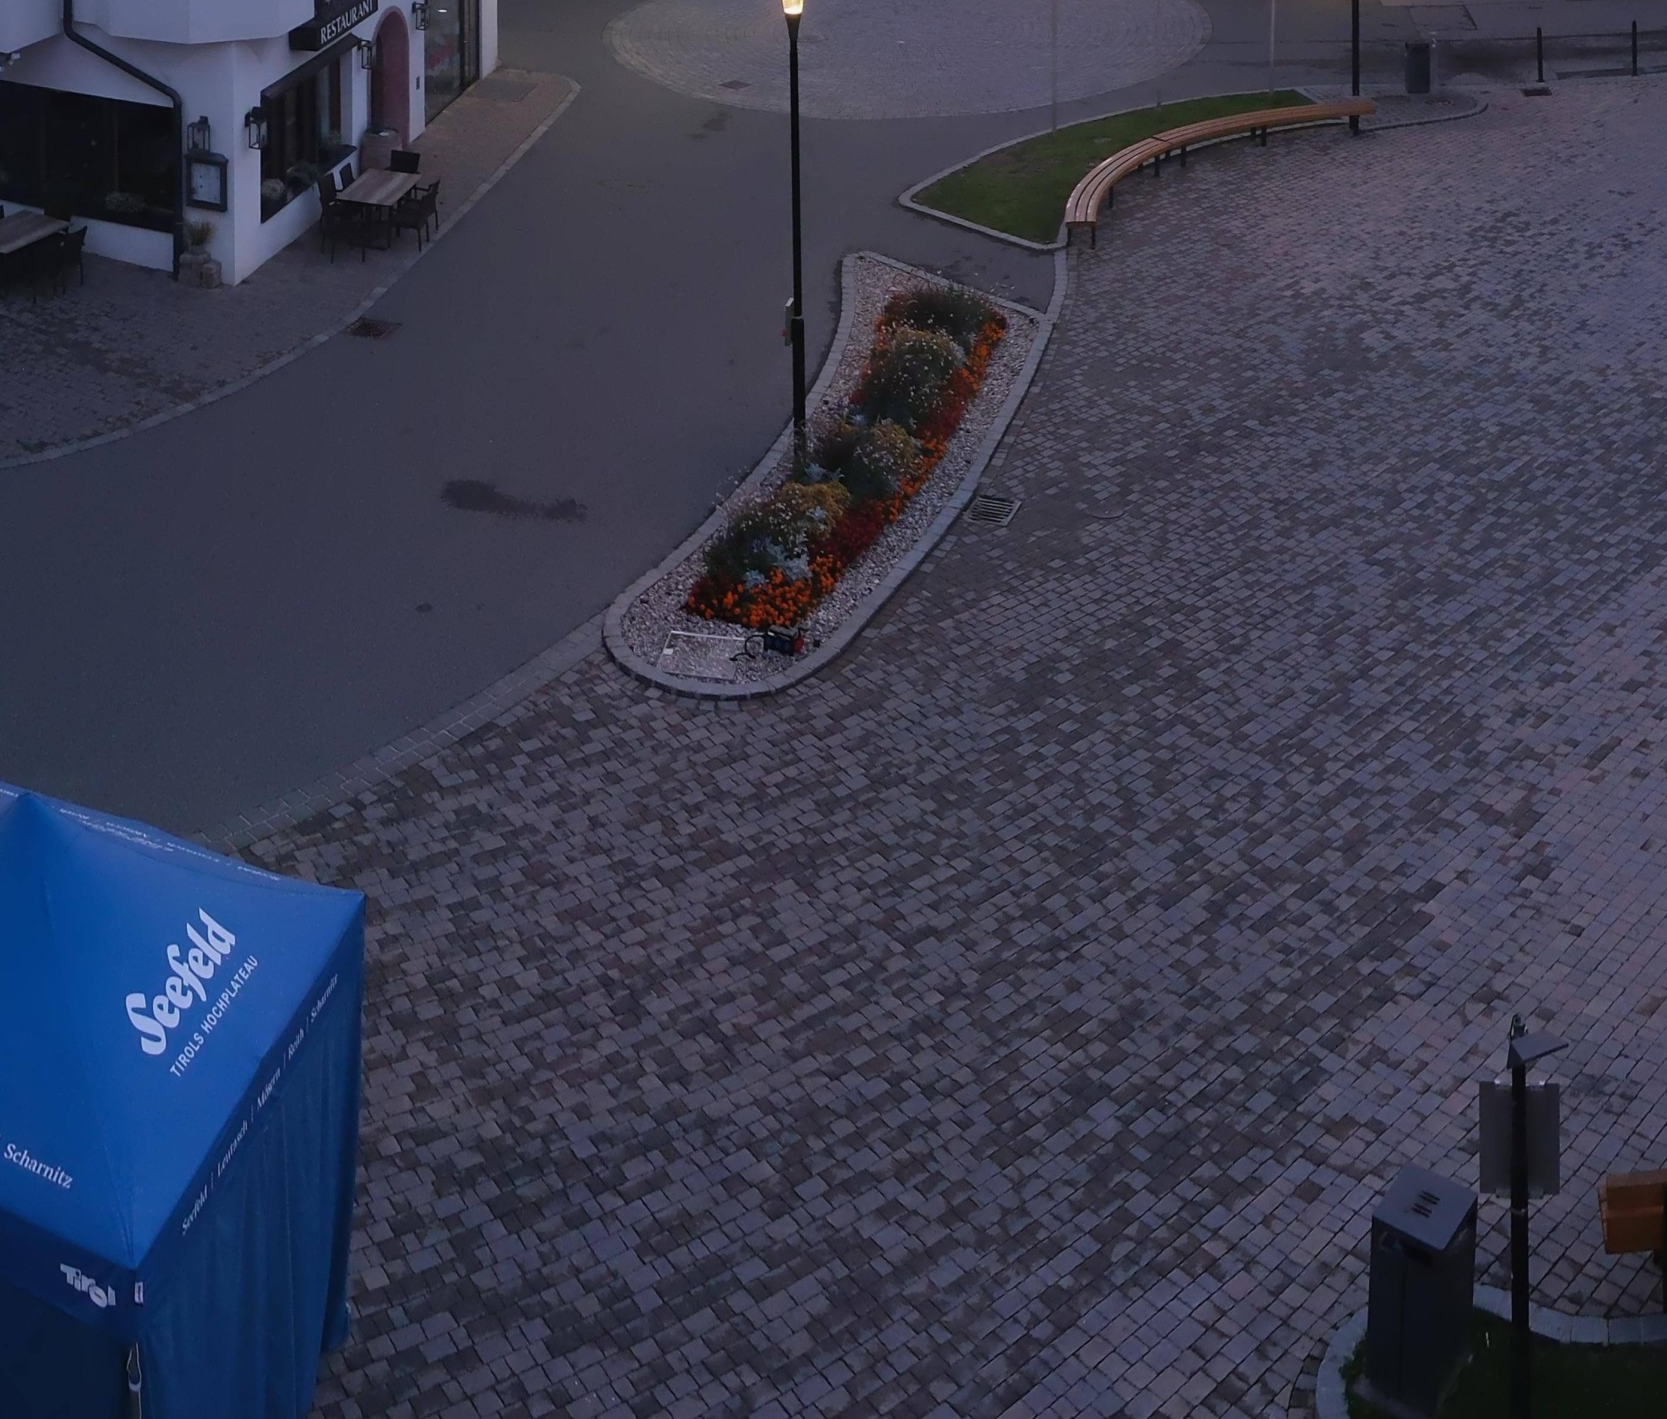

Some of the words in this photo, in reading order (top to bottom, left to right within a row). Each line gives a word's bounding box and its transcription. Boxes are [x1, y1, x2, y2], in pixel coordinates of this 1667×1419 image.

[125, 907, 236, 1056] Seefeld
[169, 1031, 205, 1078] TIROLS
[200, 955, 258, 1035] HOCHPLATEAU
[3, 1143, 74, 1189] Scharnitz
[60, 1263, 117, 1308] Tirol
